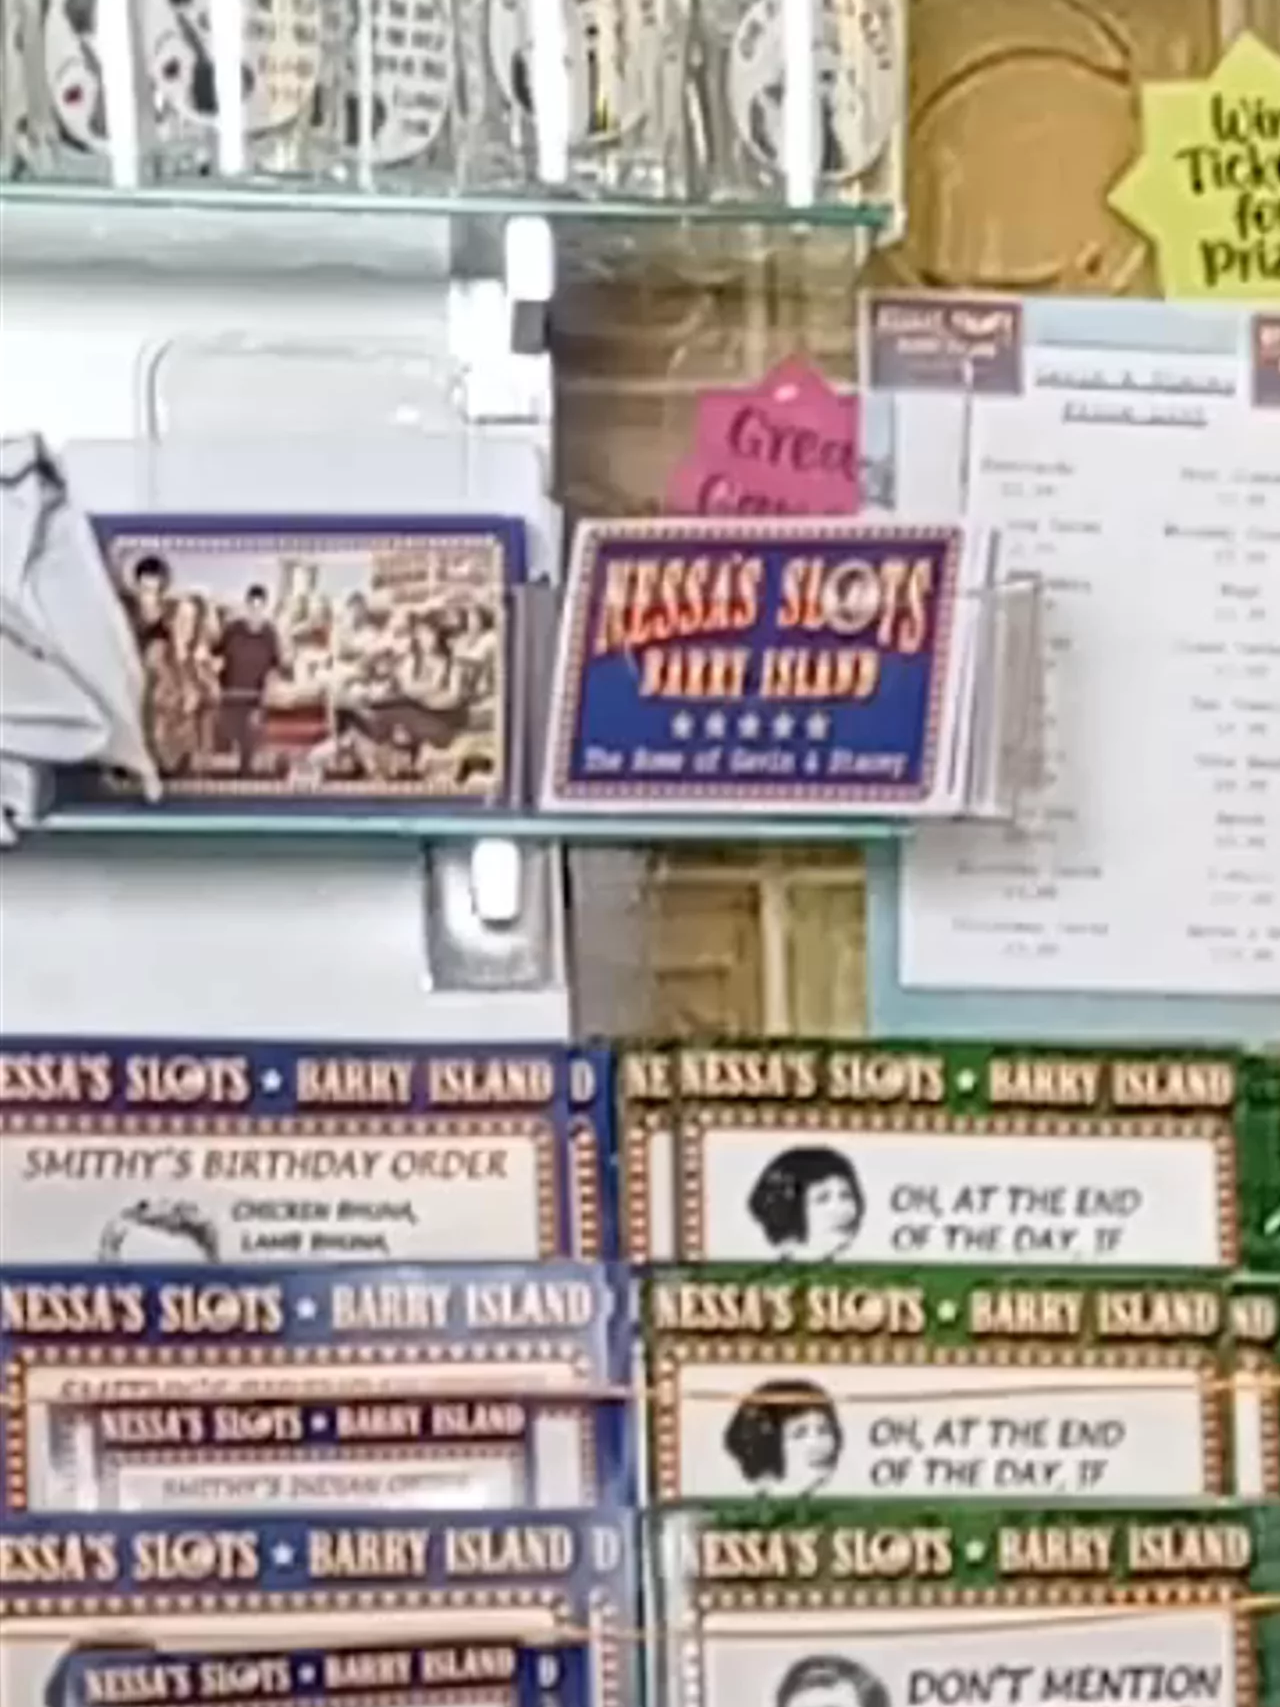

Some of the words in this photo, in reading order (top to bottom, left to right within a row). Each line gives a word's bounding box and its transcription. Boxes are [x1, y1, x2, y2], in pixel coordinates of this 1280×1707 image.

[594, 552, 763, 655] NESSA'S
[759, 647, 881, 698] ISLAND
[297, 1059, 411, 1102] BARRY
[430, 1061, 554, 1103] ISLAND
[989, 1061, 1099, 1103] BARRY
[1113, 1062, 1234, 1106] ISLAND
[23, 1148, 194, 1179] SMITHY'S
[202, 1149, 382, 1180] BIRTHDAY
[389, 1147, 508, 1179] ORDER
[950, 1186, 991, 1213] AT
[1006, 1186, 1068, 1214] THE
[1074, 1186, 1143, 1214] END
[891, 1227, 933, 1252] OF
[942, 1225, 1003, 1252] THE
[331, 1283, 451, 1330] BARRY
[466, 1282, 594, 1327] ISLAND
[971, 1290, 1084, 1334] BARRY
[1099, 1292, 1219, 1335] ISLAND
[933, 1418, 980, 1446] AT
[989, 1418, 1050, 1446] THE
[1058, 1418, 1127, 1448] END
[870, 1461, 913, 1487] OF
[923, 1461, 985, 1488] THE
[309, 1528, 430, 1577] BARRY
[445, 1527, 574, 1573] ISLAND
[999, 1527, 1114, 1573] BARRY
[1128, 1527, 1250, 1572] ISLAND
[1041, 1665, 1223, 1701] MENTION
